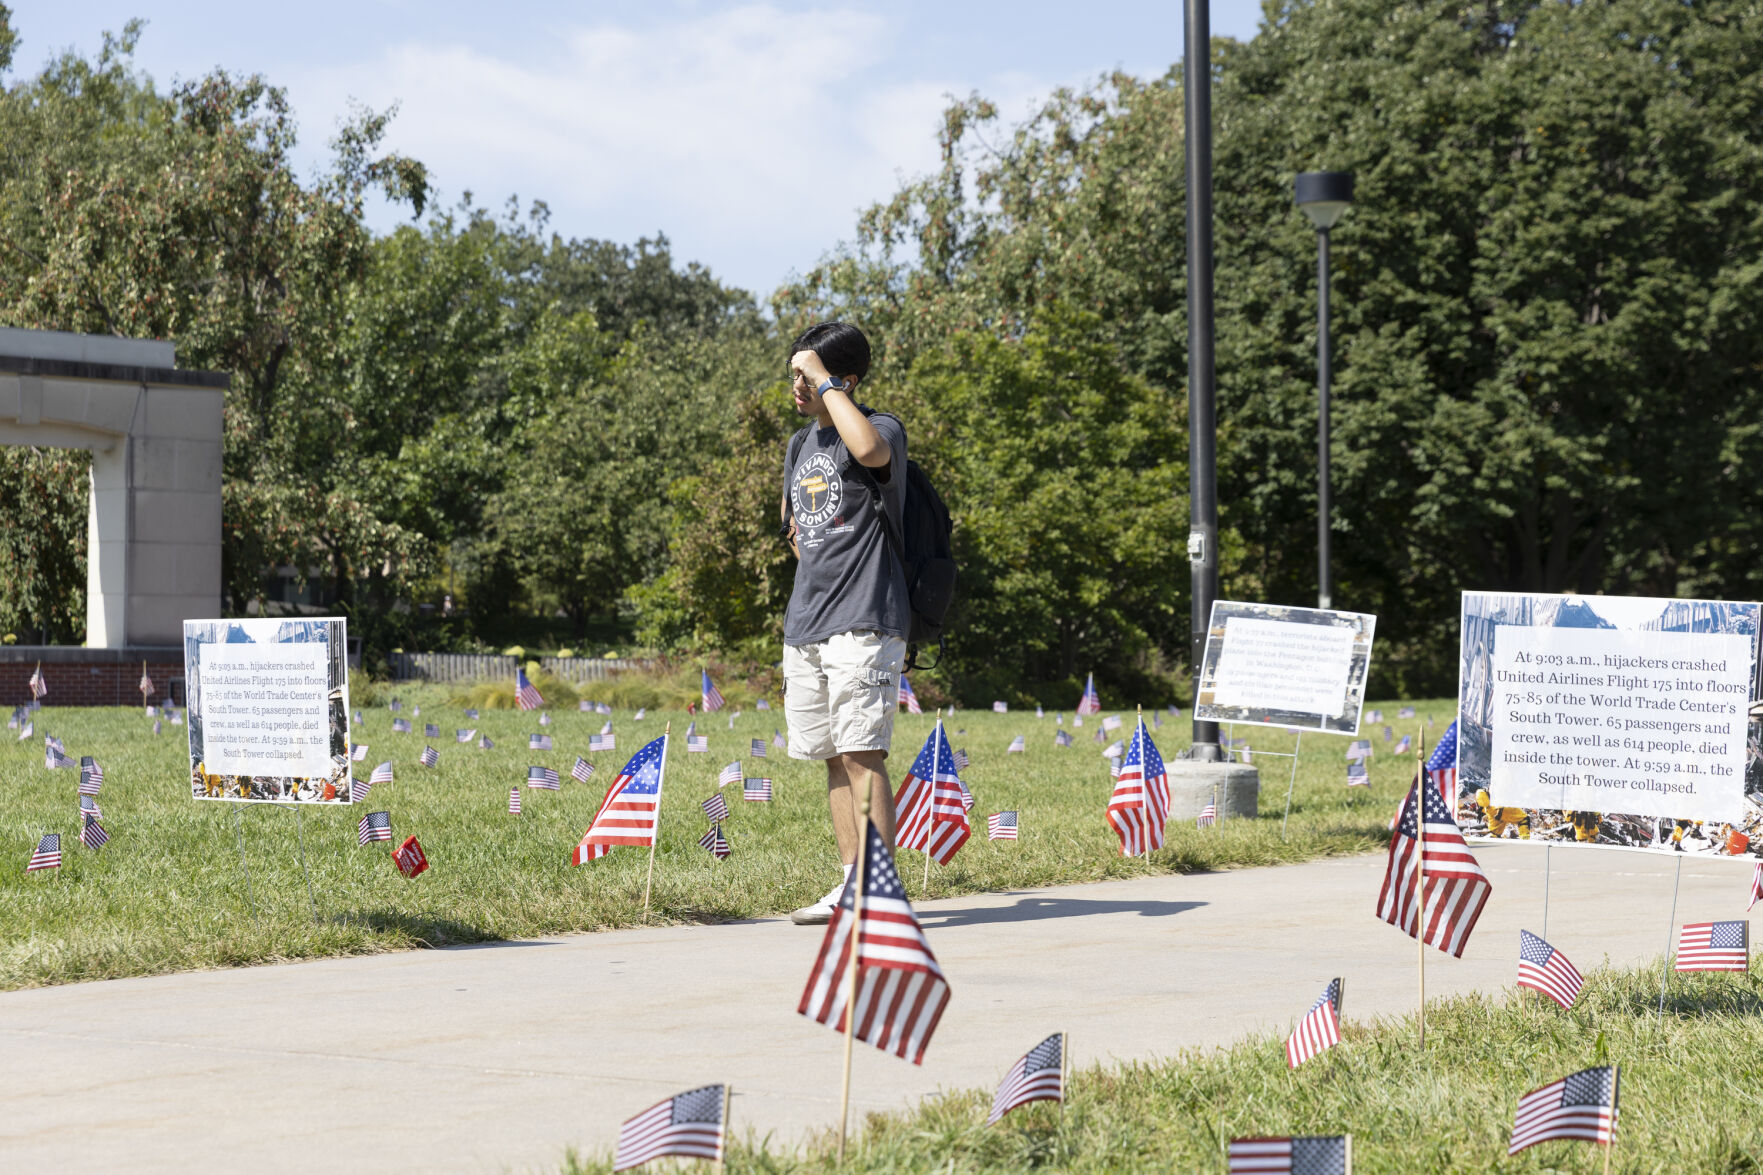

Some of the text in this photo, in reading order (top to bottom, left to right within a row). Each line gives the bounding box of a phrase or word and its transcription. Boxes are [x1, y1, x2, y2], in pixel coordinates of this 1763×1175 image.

[792, 456, 834, 512] CULTIVANDO
[800, 482, 839, 525] CAMINOS
[209, 662, 217, 670] At
[250, 662, 283, 672] hijackers
[285, 662, 314, 670] crashed
[1514, 651, 1727, 672] At 9:03 a.m., hijackers crashed
[224, 676, 250, 684] Airlines
[252, 676, 273, 687] Flight
[275, 678, 286, 687] 175
[304, 676, 326, 685] floors
[1497, 671, 1747, 694] United Airlines Flight 175 into floors
[244, 691, 264, 700] World
[267, 691, 288, 700] Trade
[290, 691, 321, 700] Center's
[1506, 692, 1736, 714] 75-85 of the World Trade Center's
[209, 705, 226, 713] South
[252, 706, 260, 715] 65
[262, 707, 303, 716] passengers
[305, 706, 319, 714] and
[236, 720, 250, 728] well
[261, 721, 272, 730] 614
[302, 721, 318, 729] died
[1509, 711, 1730, 734] South Tower. 65 passengers and
[272, 736, 288, 745] 9:59
[310, 736, 323, 744] the
[1511, 734, 1727, 755] crew, as well as 614 people, died
[224, 749, 241, 757] South
[242, 750, 265, 758] Tower
[1504, 751, 1733, 776] inside the tower. At 9:59 a.m., the
[1538, 772, 1696, 794] South Tower collapsed.
